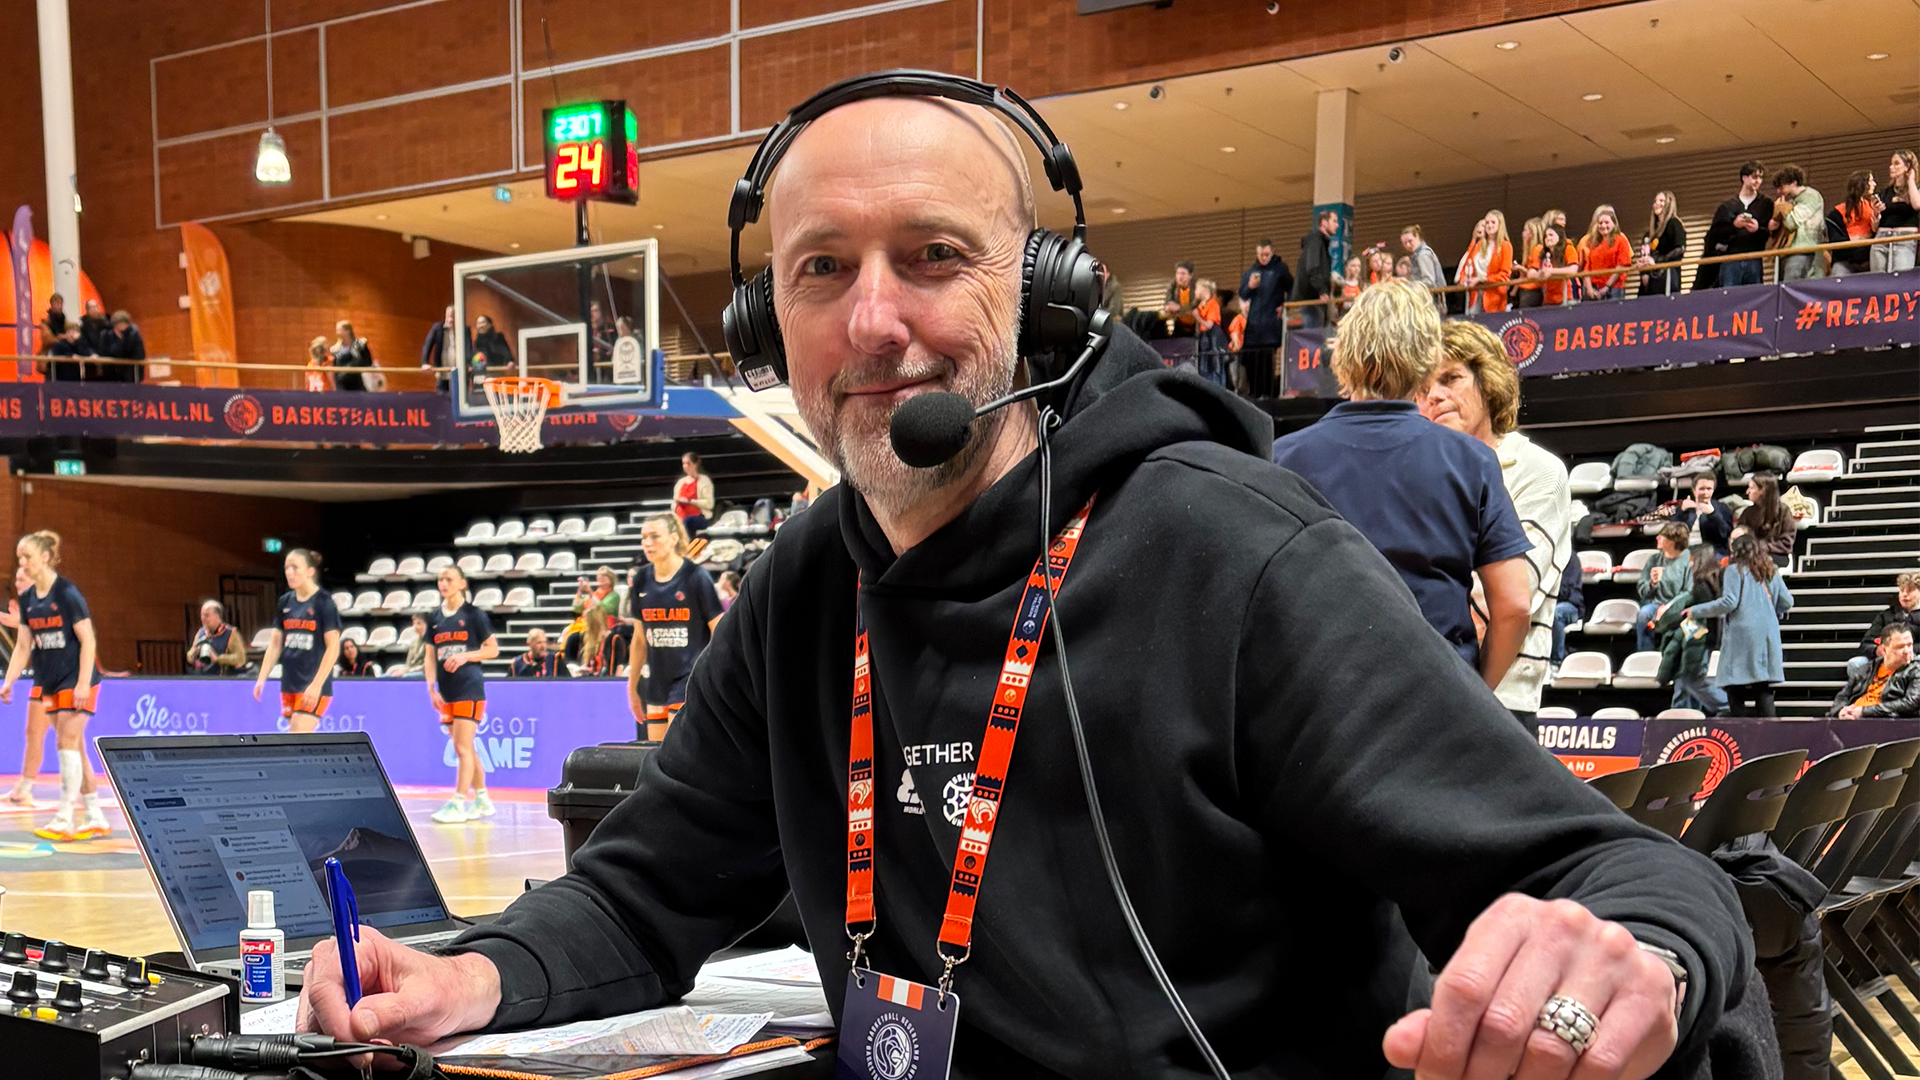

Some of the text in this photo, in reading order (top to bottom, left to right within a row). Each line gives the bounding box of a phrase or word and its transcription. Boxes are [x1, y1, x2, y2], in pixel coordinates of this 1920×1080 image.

[556, 143, 603, 189] 24
[1796, 290, 1920, 330] #READY
[1554, 310, 1764, 352] BASKETBALL.NL
[50, 397, 214, 423] BASKETBALL.NL
[271, 405, 431, 427] BASKETBALL.NL
[128, 694, 170, 730] She
[322, 715, 366, 732] GOT
[490, 717, 539, 736] GOT
[903, 741, 975, 767] GETHER
